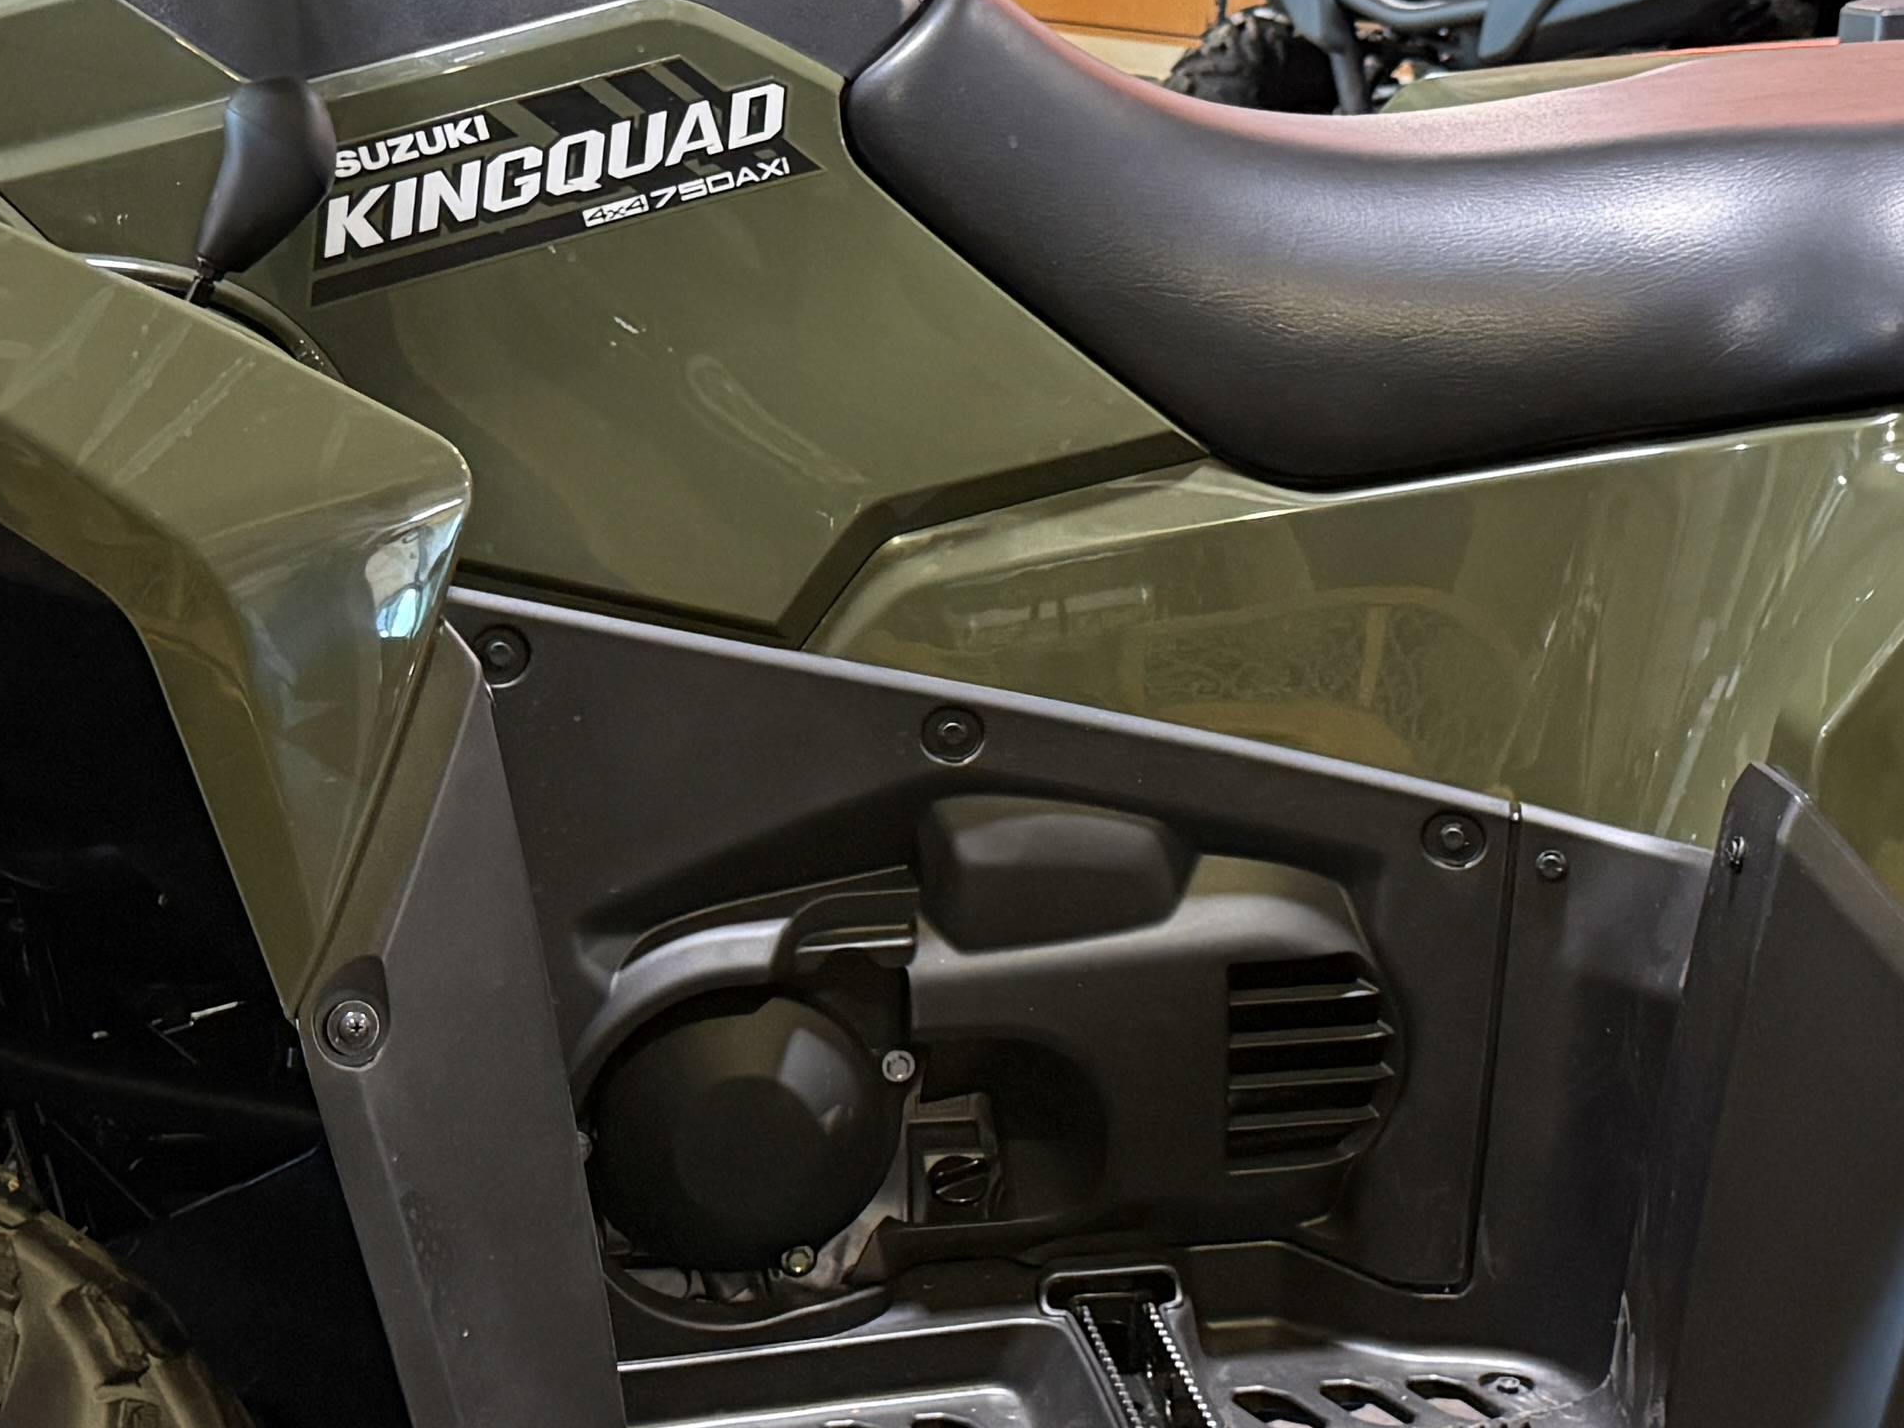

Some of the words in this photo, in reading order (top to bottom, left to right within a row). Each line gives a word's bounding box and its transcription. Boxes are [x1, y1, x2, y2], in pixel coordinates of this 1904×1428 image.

[324, 83, 785, 258] KINGQUAD
[335, 114, 491, 178] SUZUKI
[650, 157, 790, 209] 750AXI
